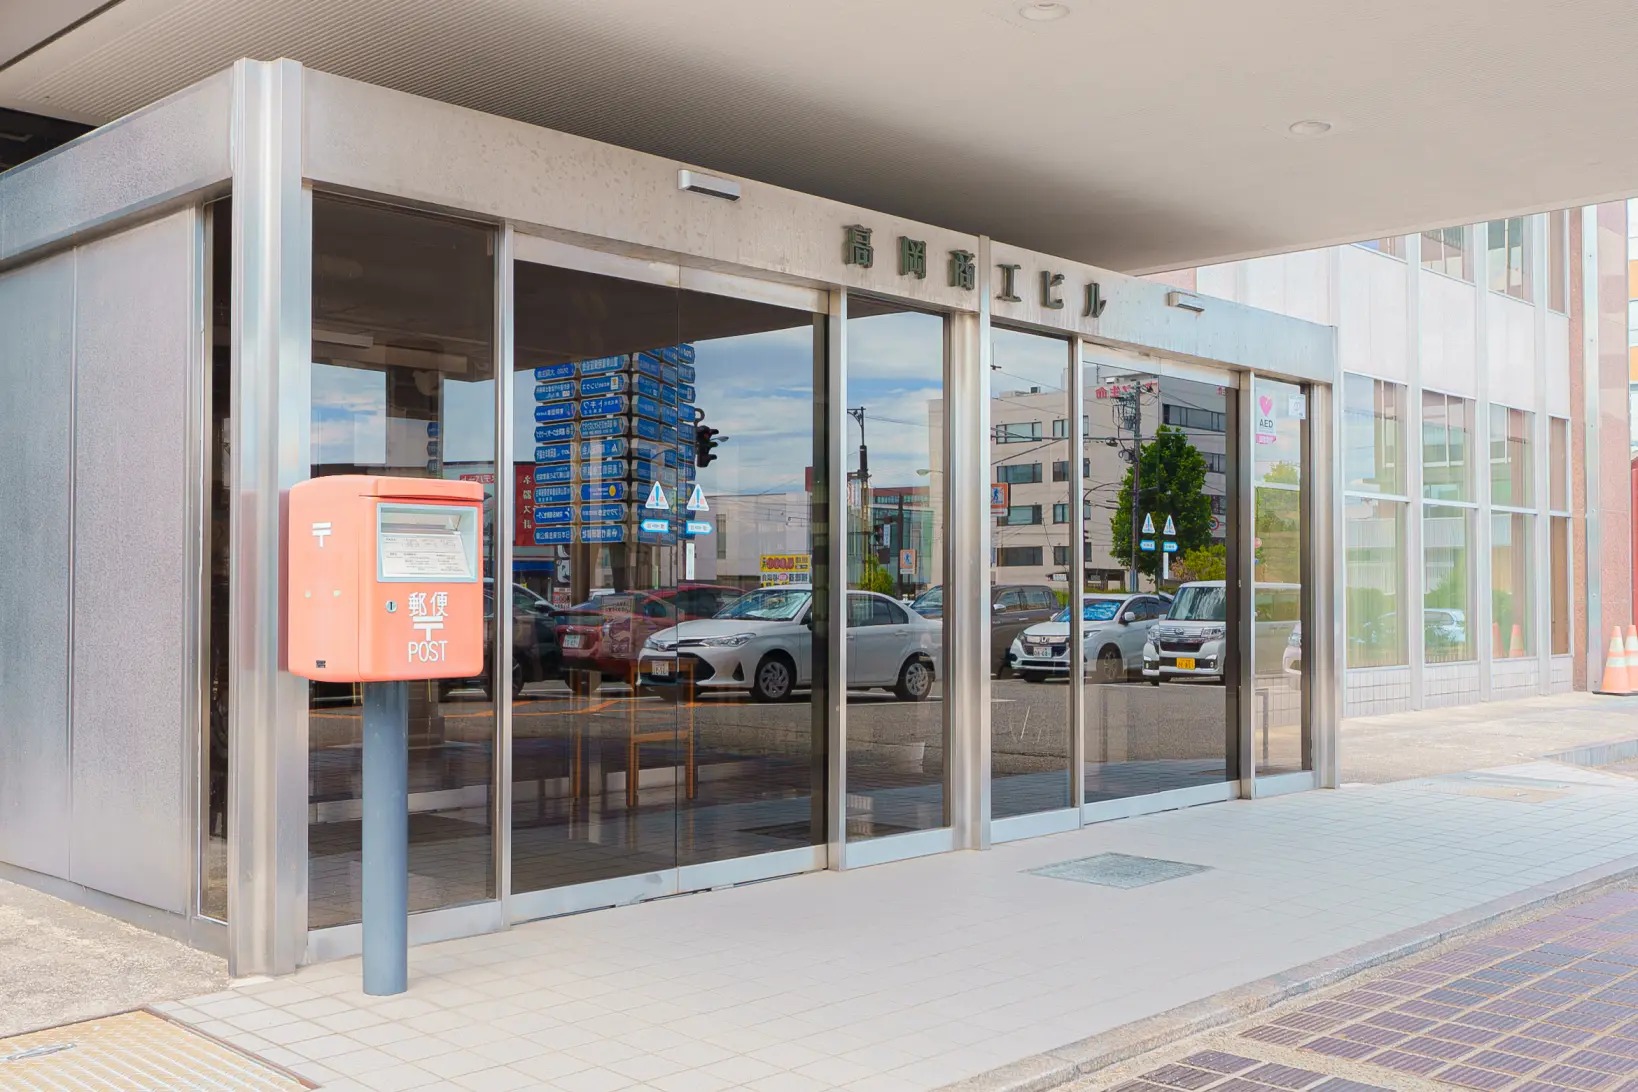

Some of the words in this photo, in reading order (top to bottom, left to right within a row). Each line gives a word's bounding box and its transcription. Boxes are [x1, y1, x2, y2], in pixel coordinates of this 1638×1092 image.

[1259, 418, 1274, 428] AED
[408, 591, 448, 617] 郵便
[408, 640, 448, 662] POST
